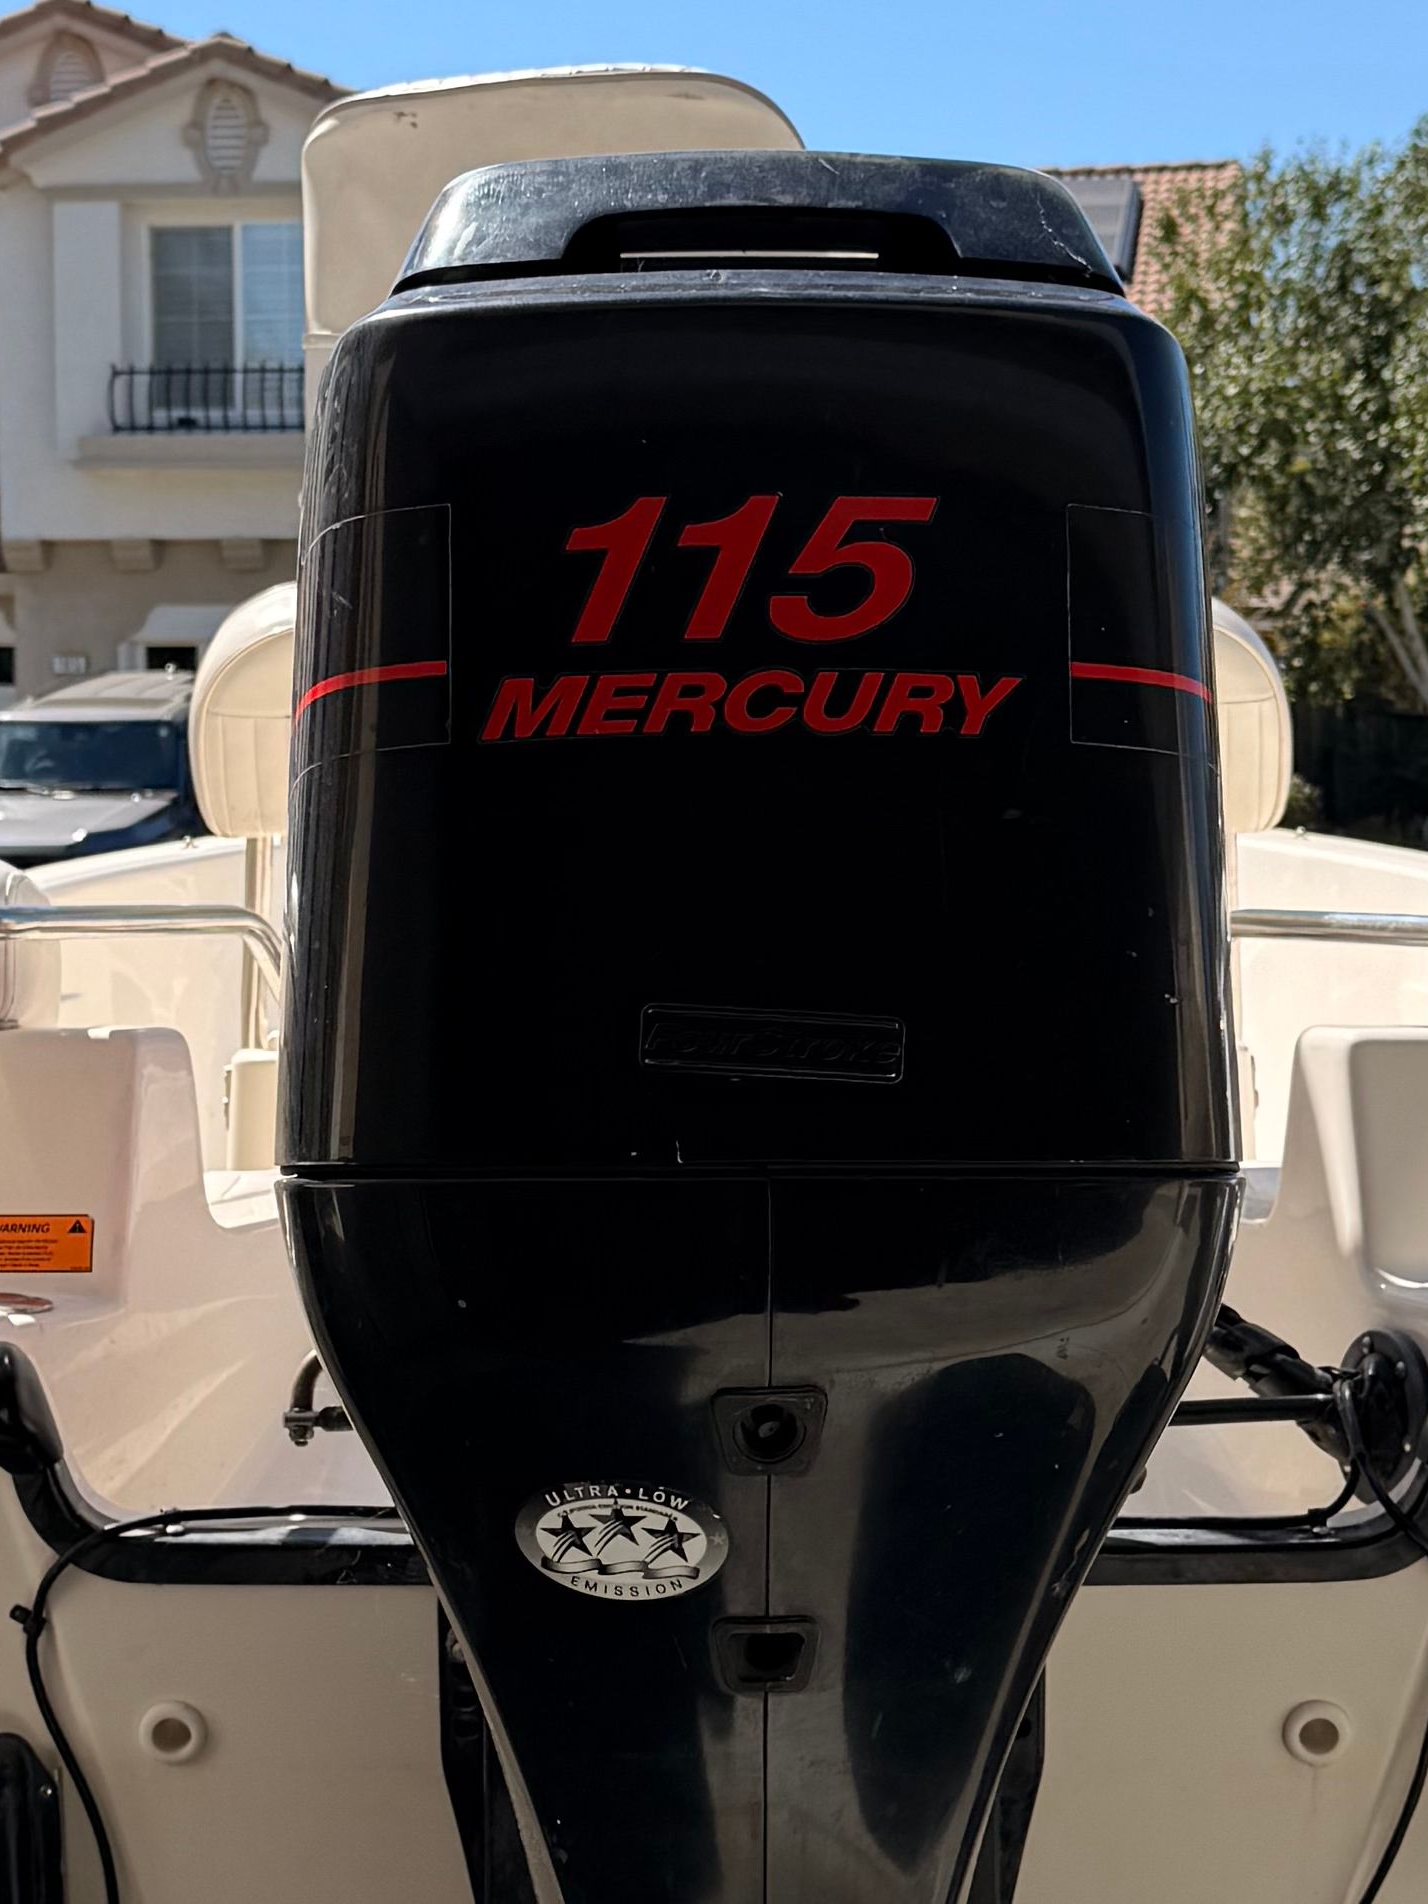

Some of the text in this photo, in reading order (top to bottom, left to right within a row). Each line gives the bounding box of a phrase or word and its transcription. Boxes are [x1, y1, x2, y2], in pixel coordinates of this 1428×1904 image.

[564, 495, 939, 642] 115
[482, 670, 1019, 740] MERCURY
[545, 1484, 691, 1510] ULTRA LOW
[570, 1576, 684, 1597] EMISSION
